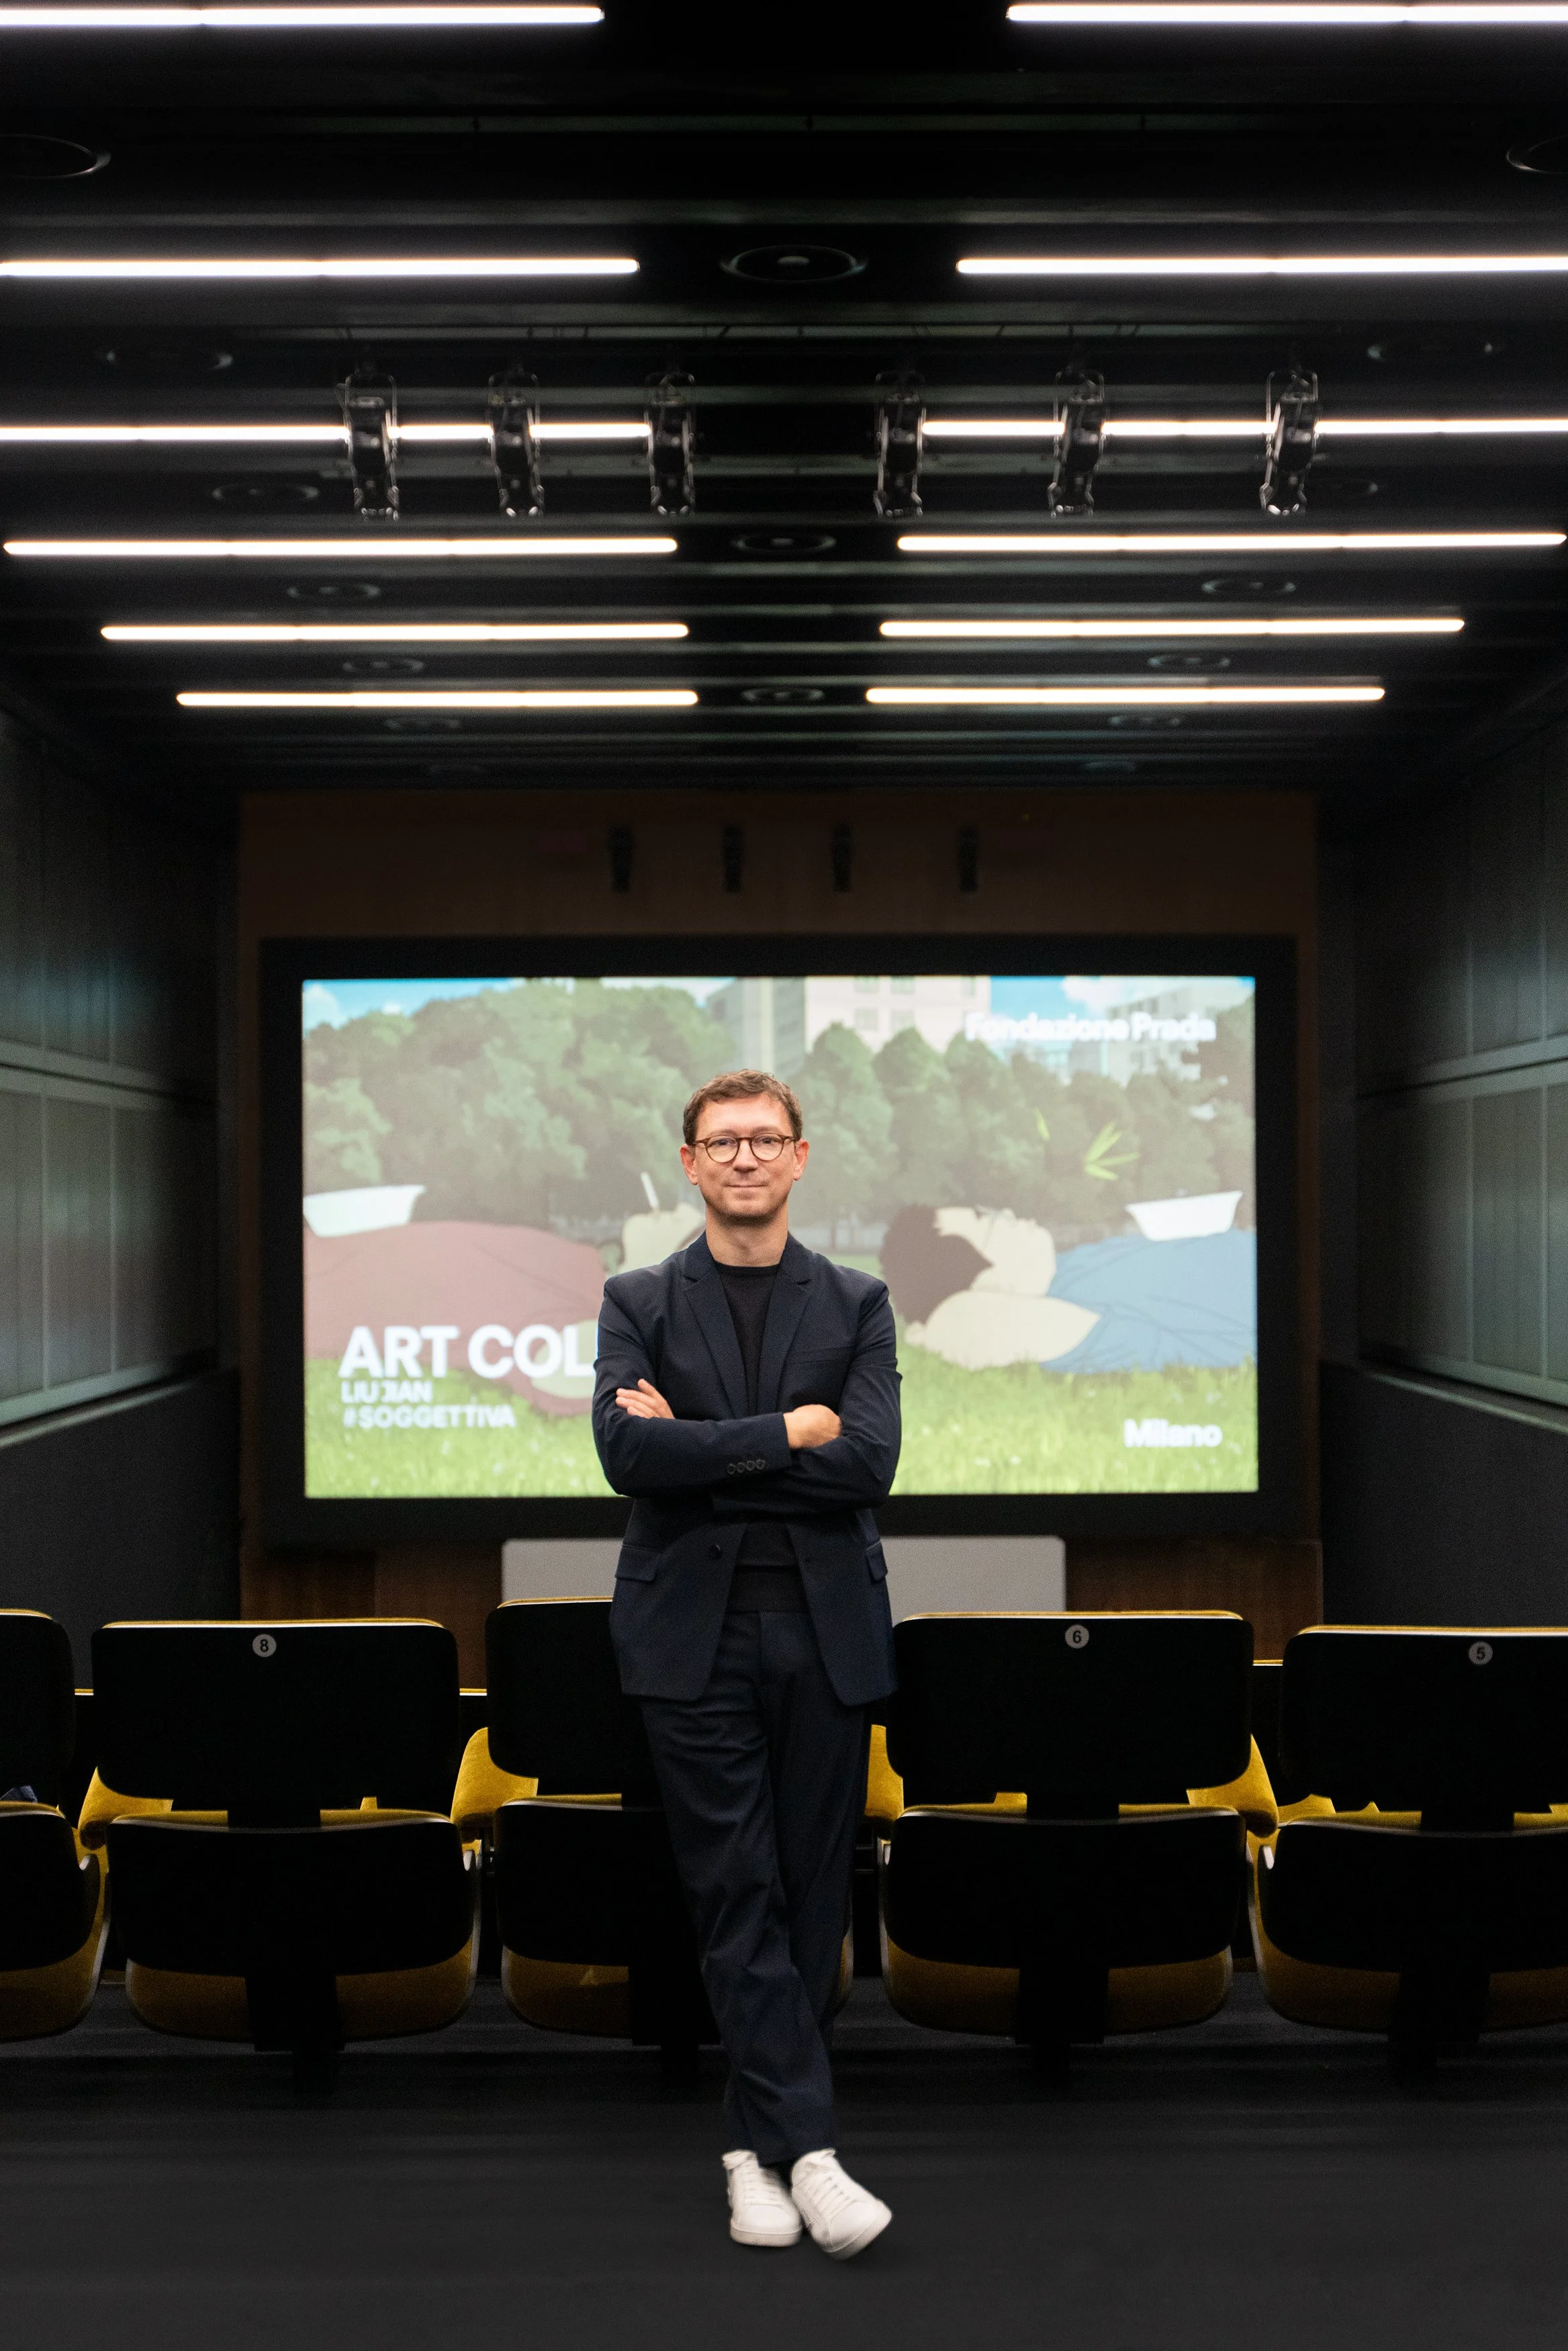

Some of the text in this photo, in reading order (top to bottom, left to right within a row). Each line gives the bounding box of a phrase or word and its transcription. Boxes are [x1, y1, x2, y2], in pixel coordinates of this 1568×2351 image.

[965, 1012, 1216, 1040] Fondazione Prada
[338, 1325, 459, 1378] ART
[341, 1381, 433, 1403] LIU JIAN
[343, 1405, 516, 1429] #SOGGETTIVA
[1124, 1419, 1223, 1448] Milano
[260, 1639, 269, 1652] 8
[1072, 1630, 1082, 1644] 6
[1477, 1646, 1485, 1660] 5
